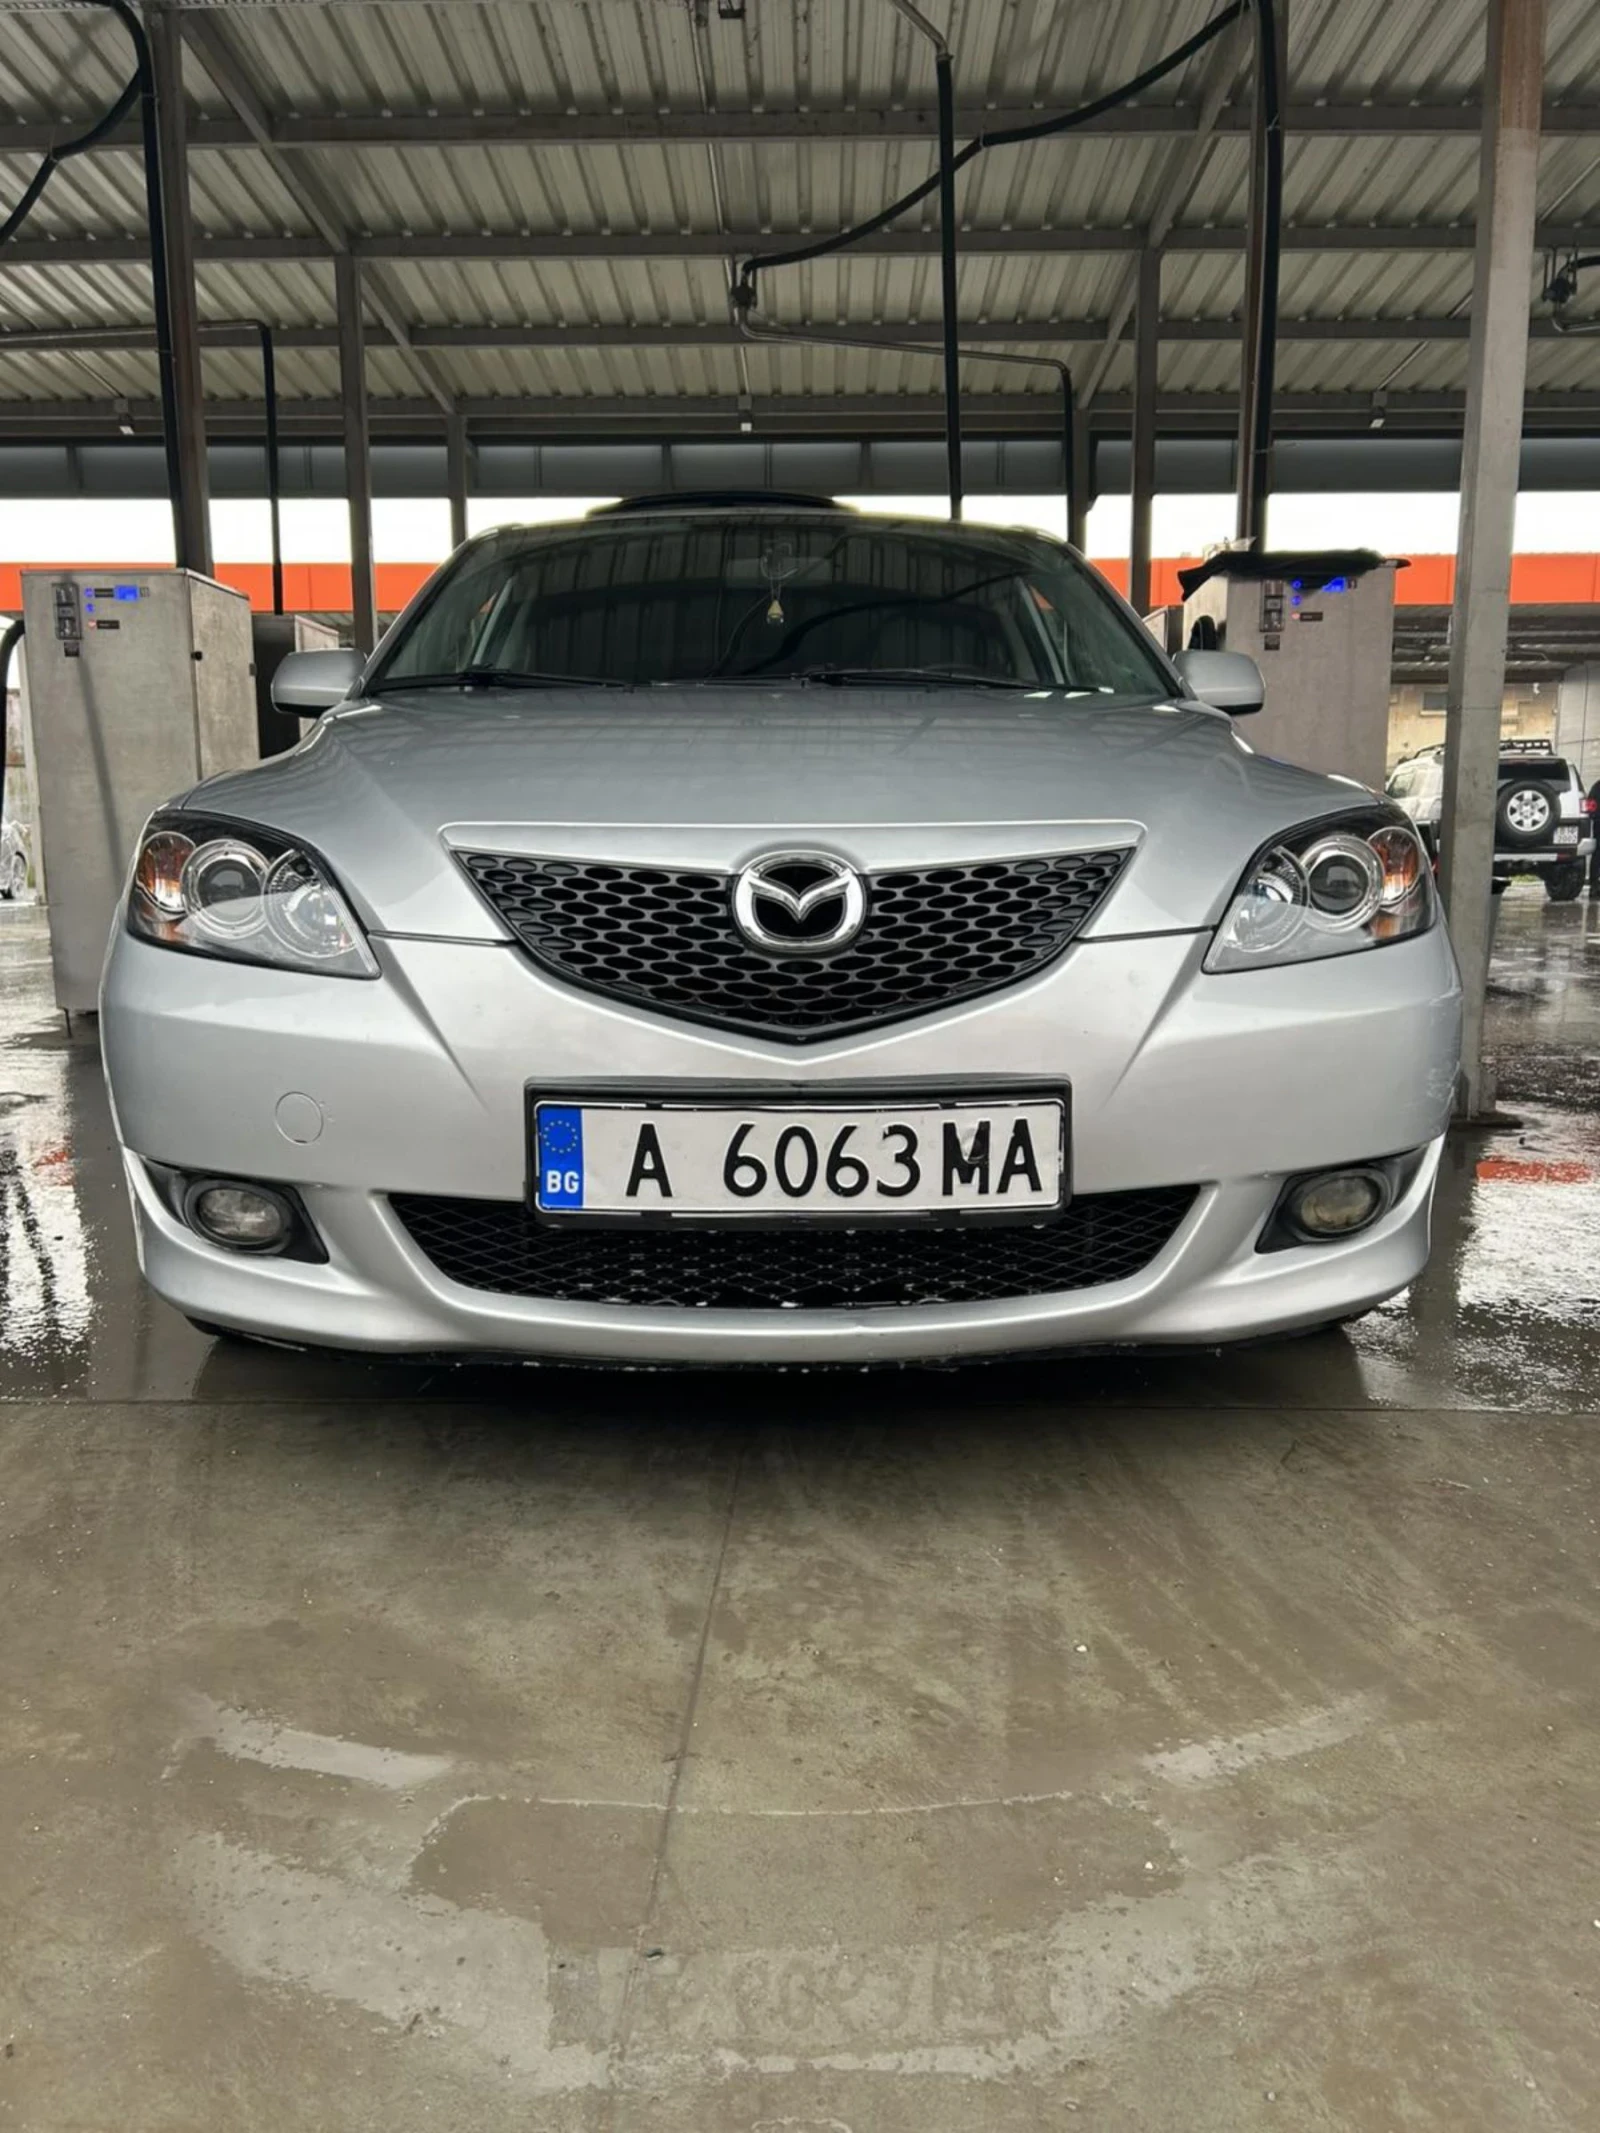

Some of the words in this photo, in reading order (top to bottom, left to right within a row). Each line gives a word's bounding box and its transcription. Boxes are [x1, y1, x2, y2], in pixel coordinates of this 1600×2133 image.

[546, 1169, 580, 1194] BG
[625, 1123, 673, 1198] A
[723, 1123, 921, 1198] 6063
[942, 1118, 1043, 1197] MA
